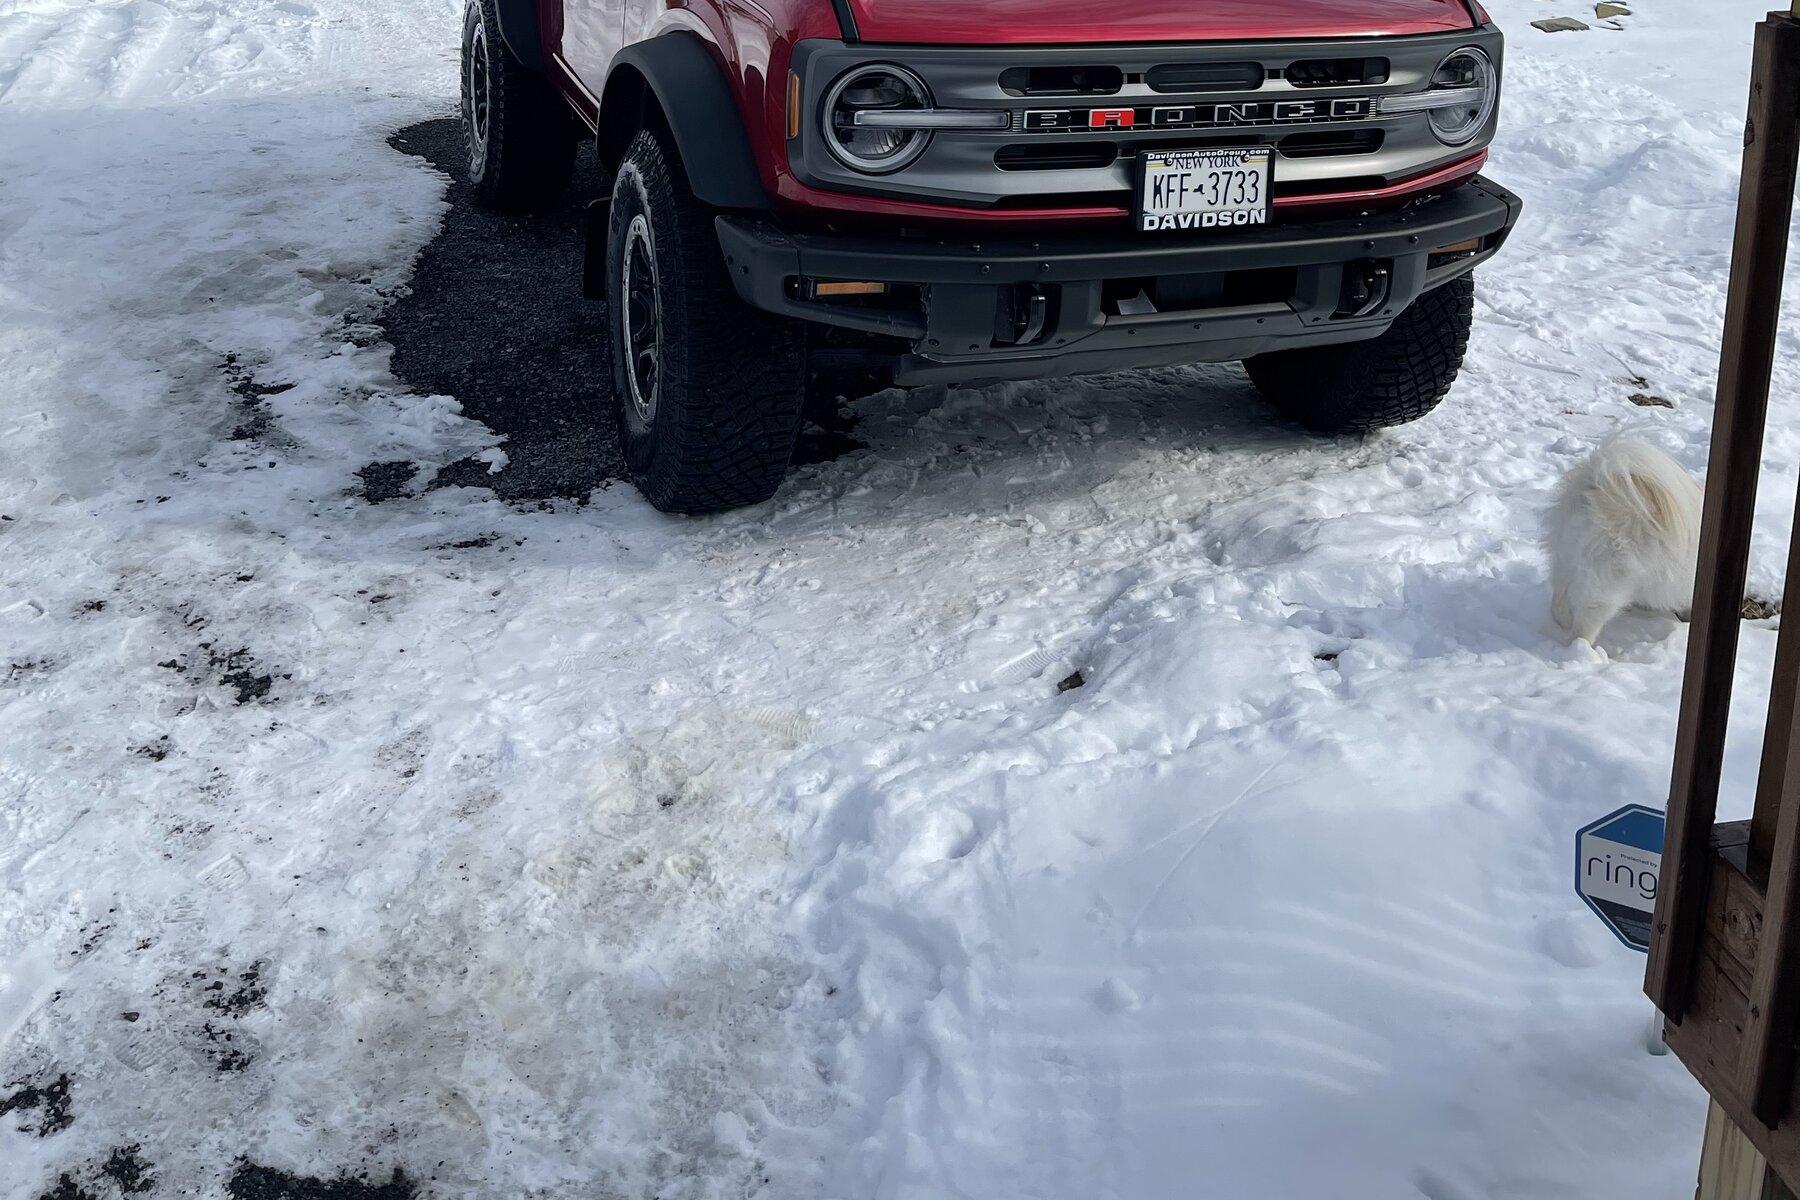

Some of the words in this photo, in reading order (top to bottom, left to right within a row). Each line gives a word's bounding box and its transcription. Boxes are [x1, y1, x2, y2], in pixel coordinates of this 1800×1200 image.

[1024, 98, 1370, 130] BRONCO
[1147, 148, 1270, 160] DavidsonAutoGroup.com
[1175, 158, 1204, 170] NEW
[1208, 155, 1240, 168] YORK
[1143, 209, 1266, 231] DAVIDSON
[1587, 854, 1658, 900] ring
